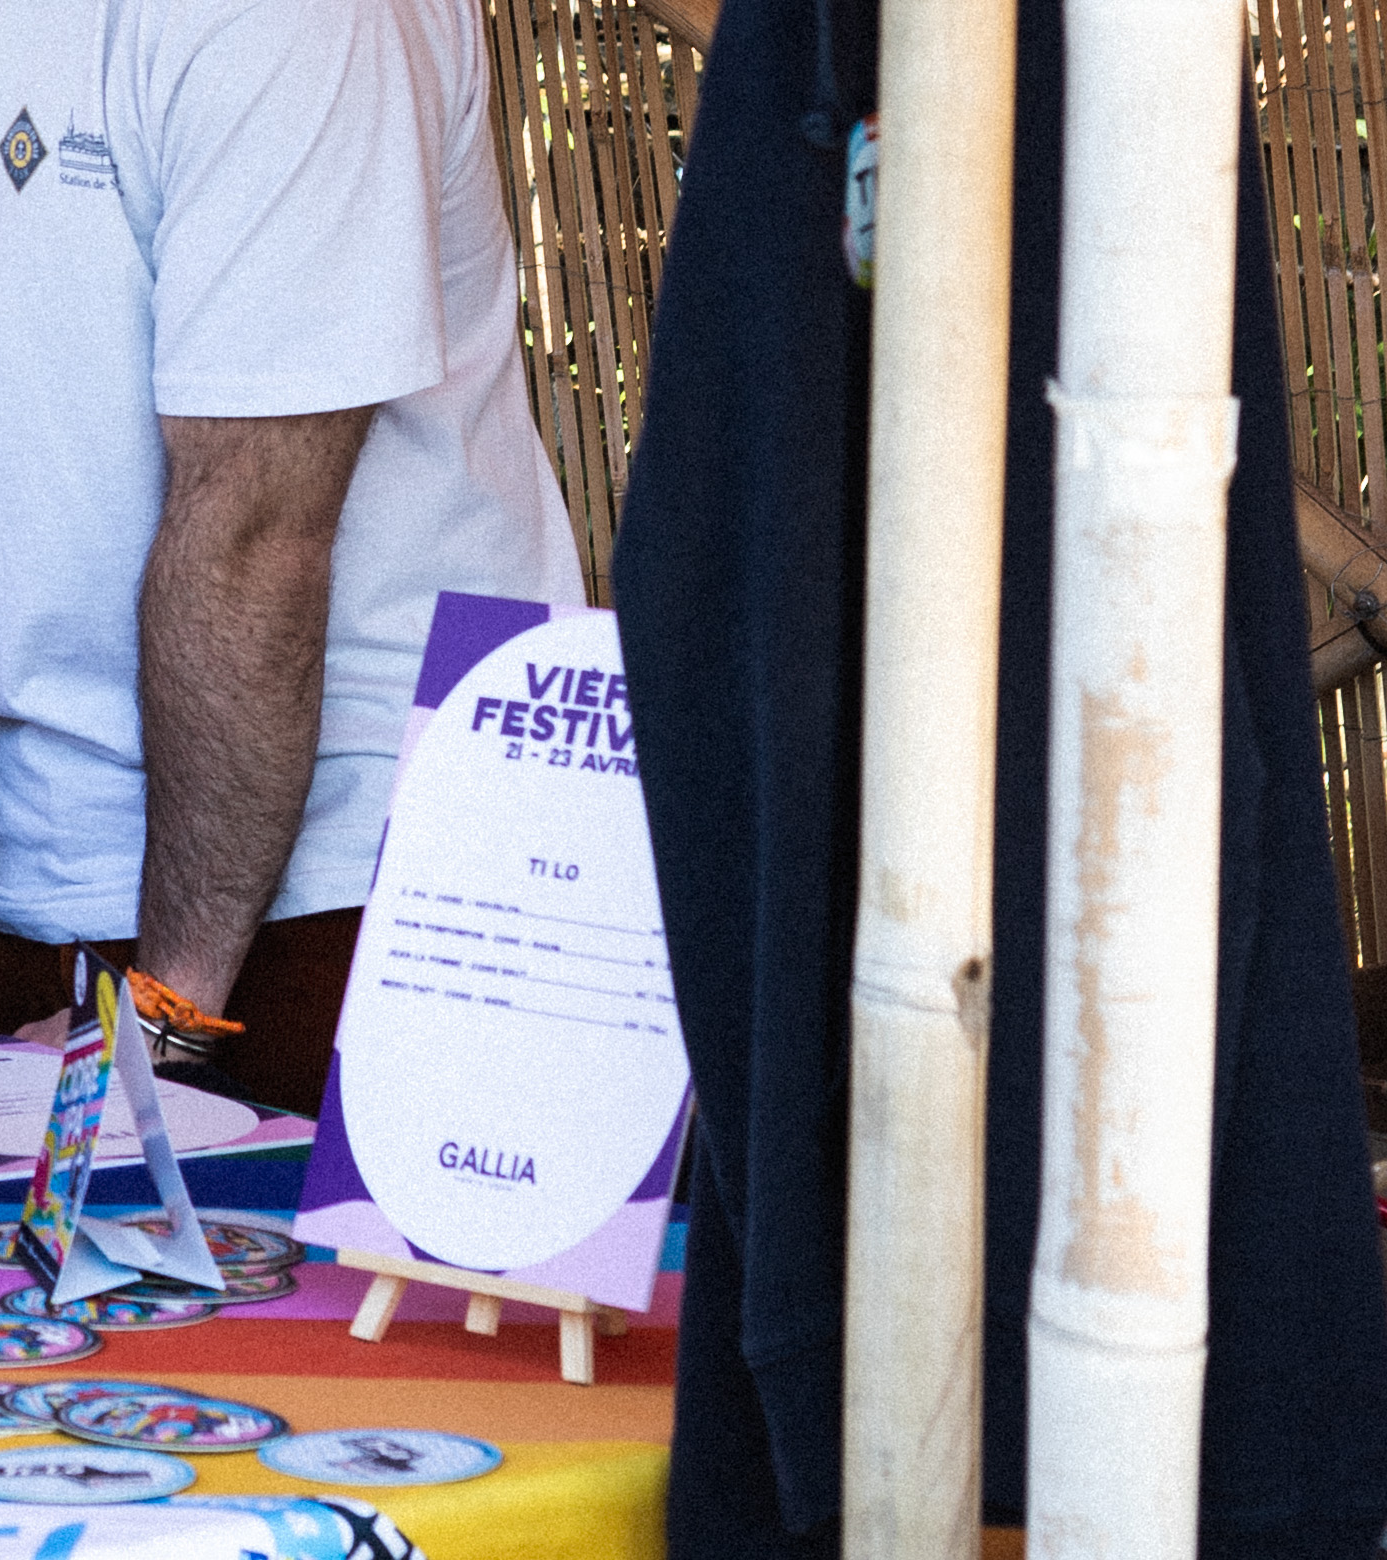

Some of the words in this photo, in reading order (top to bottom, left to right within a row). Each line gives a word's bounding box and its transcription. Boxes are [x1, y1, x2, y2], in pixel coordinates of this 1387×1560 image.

[505, 742, 523, 759] 21
[548, 748, 572, 767] 23
[530, 858, 547, 876] TI
[554, 863, 579, 880] LO
[440, 1142, 535, 1184] GALLIA
